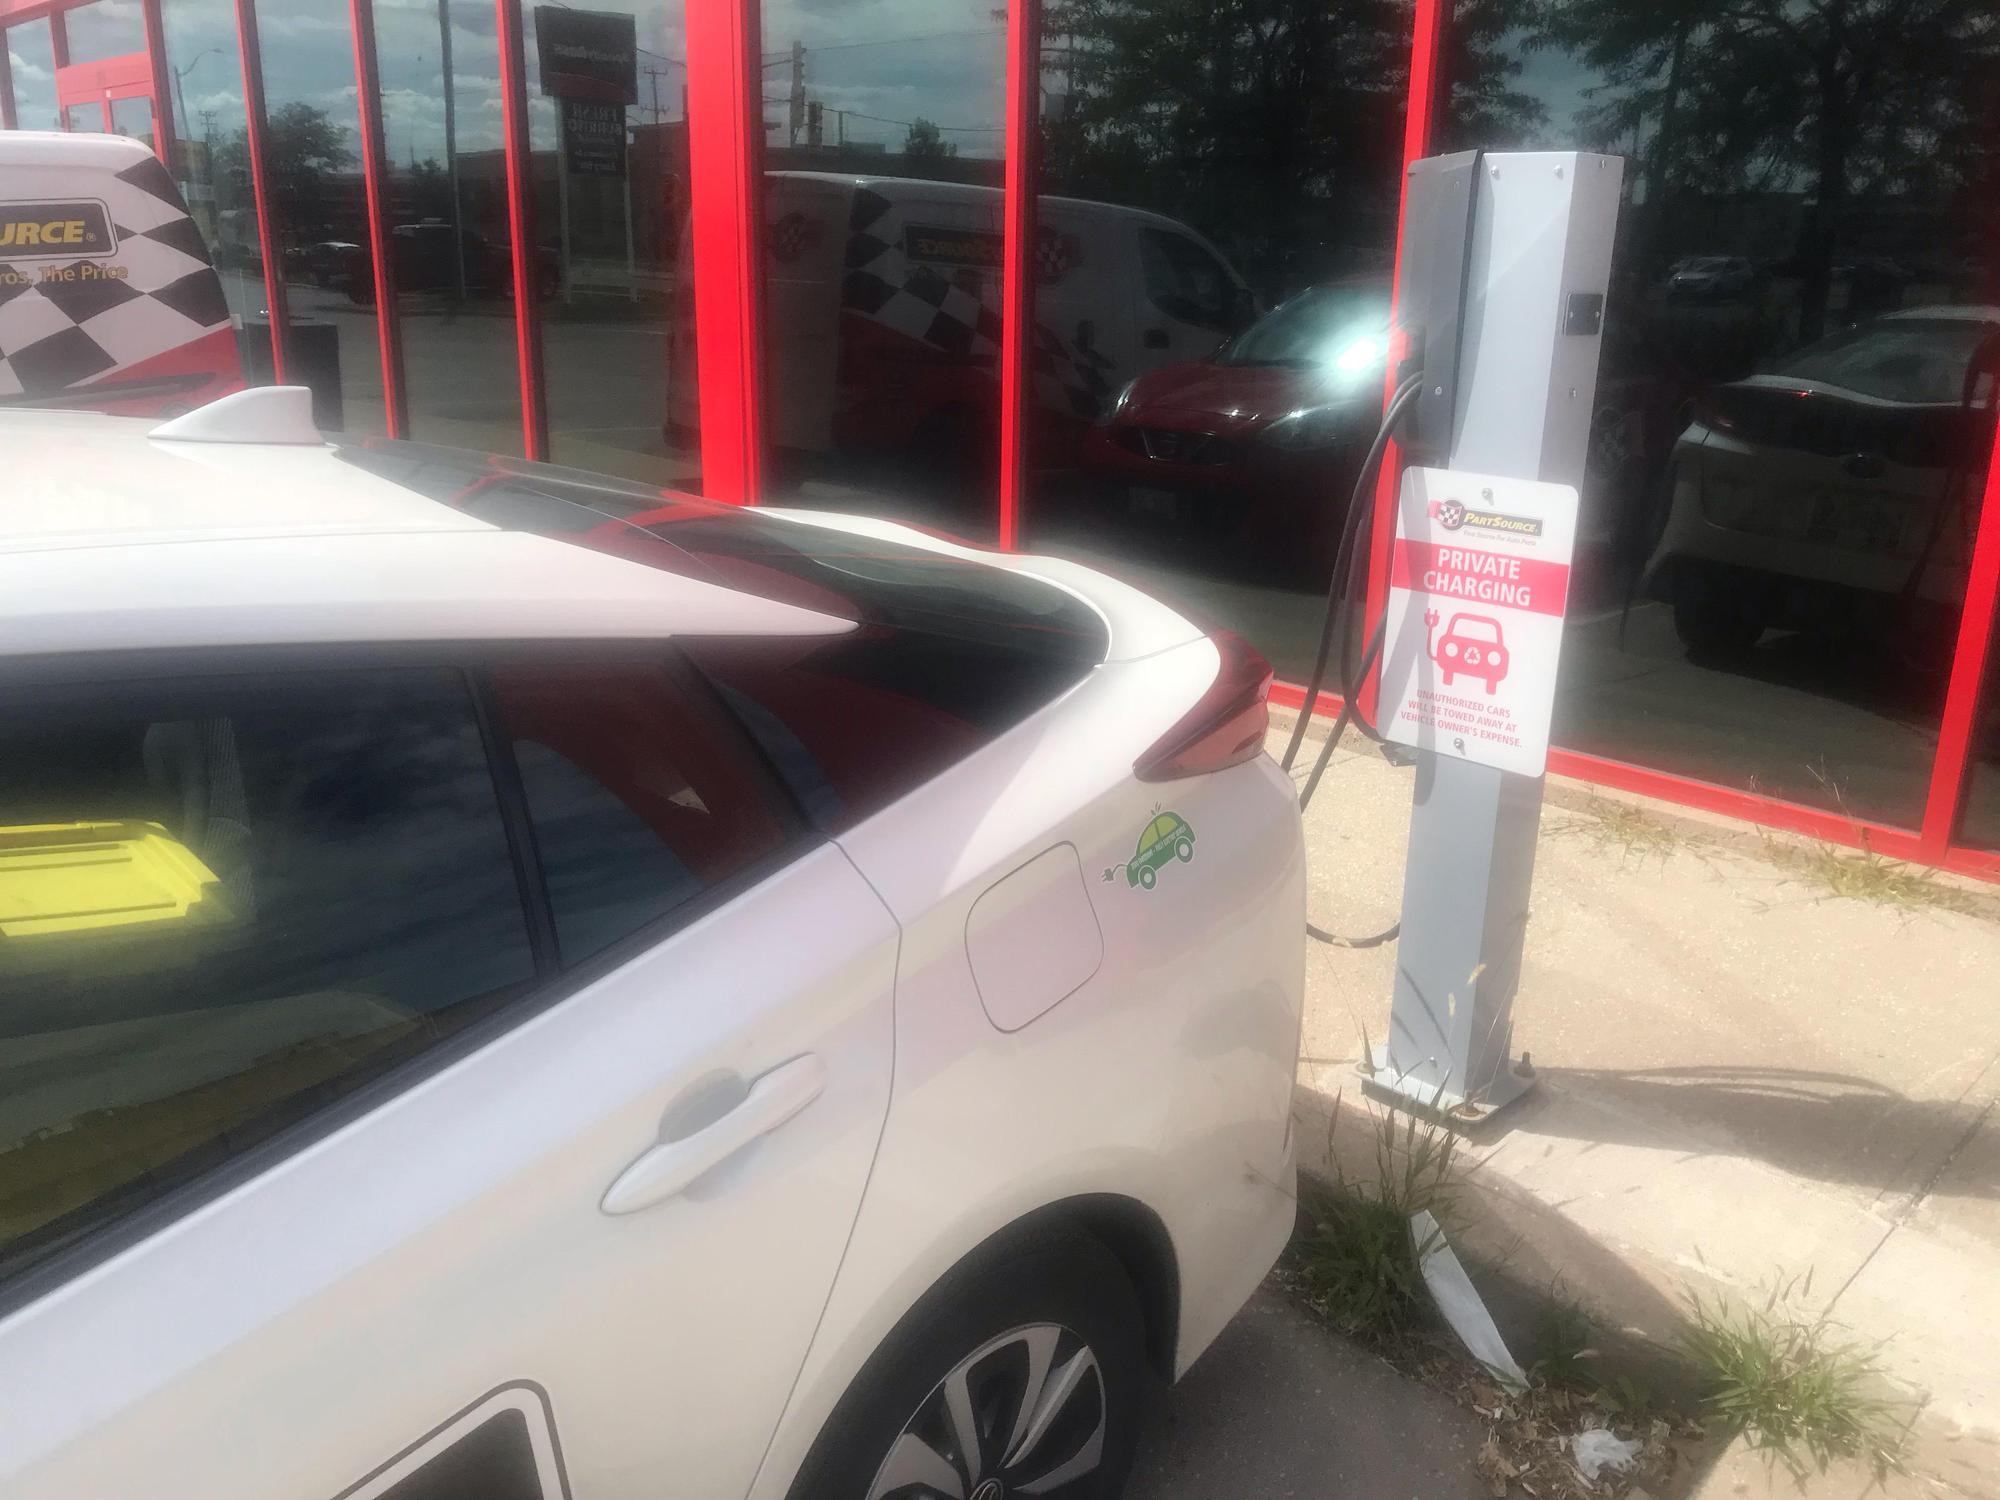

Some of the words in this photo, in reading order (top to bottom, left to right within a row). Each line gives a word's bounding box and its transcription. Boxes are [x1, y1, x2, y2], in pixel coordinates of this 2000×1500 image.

[38, 264, 75, 282] The
[81, 263, 128, 280] Price
[1438, 548, 1520, 580] PRIVATE
[1423, 570, 1531, 607] CHARGING
[1408, 700, 1428, 712] WILL
[1430, 705, 1441, 715] BE
[1444, 708, 1475, 723] TOWED
[1477, 716, 1504, 730] AWAY
[1505, 723, 1518, 733] AT
[1417, 689, 1484, 711] UNAUTHORIZED
[1487, 705, 1511, 718] CARS
[1401, 711, 1435, 726] VEHICLE
[1438, 719, 1478, 737] OWNER'S
[1480, 729, 1523, 748] EXPENSE.
